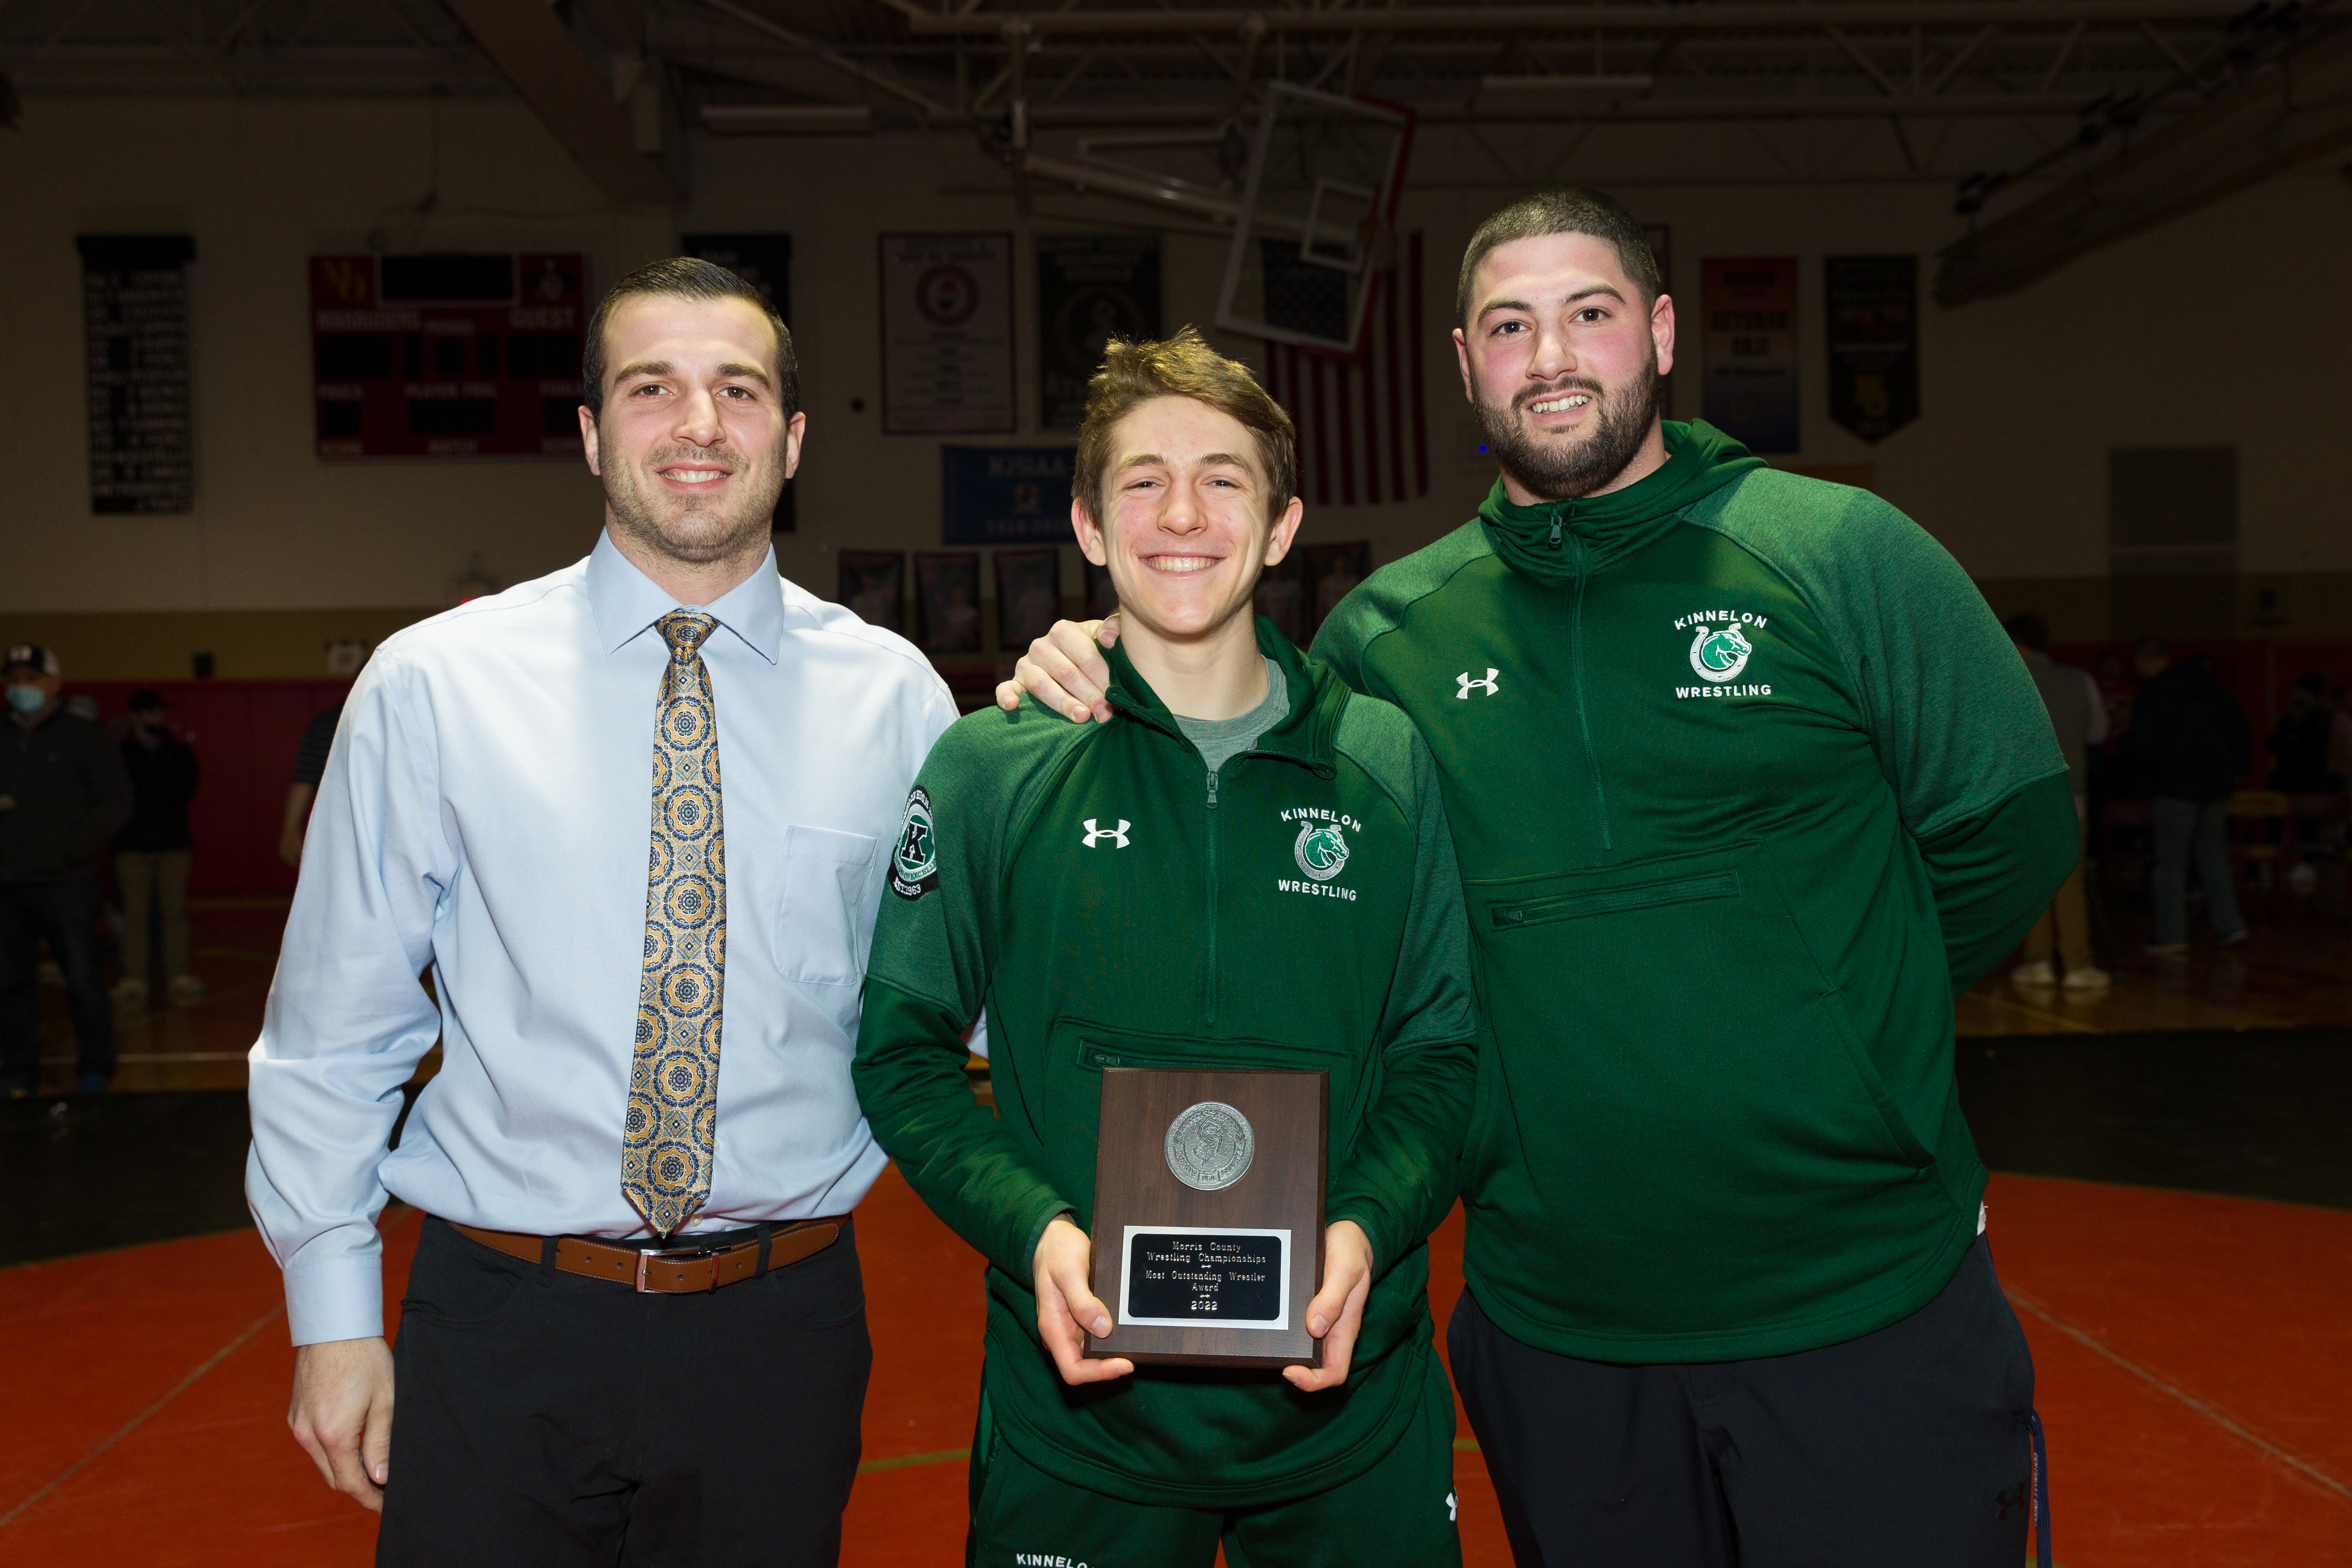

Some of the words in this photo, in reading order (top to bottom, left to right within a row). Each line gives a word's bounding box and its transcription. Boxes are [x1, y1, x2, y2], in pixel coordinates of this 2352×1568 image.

[508, 306, 576, 328] GUEST
[1674, 610, 1767, 630] KINNELON
[1675, 684, 1771, 698] WRESTLING
[1280, 808, 1361, 832] KINNELON
[900, 821, 928, 865] K
[1278, 879, 1357, 901] WRESTLING
[1221, 1148, 1242, 1175] COUNTY
[1173, 1241, 1202, 1250] Morris
[1210, 1242, 1241, 1252] County
[1147, 1252, 1191, 1263] Wrestling
[1198, 1253, 1266, 1264] Championships
[1145, 1270, 1165, 1279] Most
[1171, 1271, 1222, 1282] Outstanding
[1229, 1271, 1266, 1281] Wrestler
[1191, 1283, 1219, 1291] Award
[1191, 1301, 1217, 1310] 2022
[1016, 1553, 1094, 1568] KINNELO
